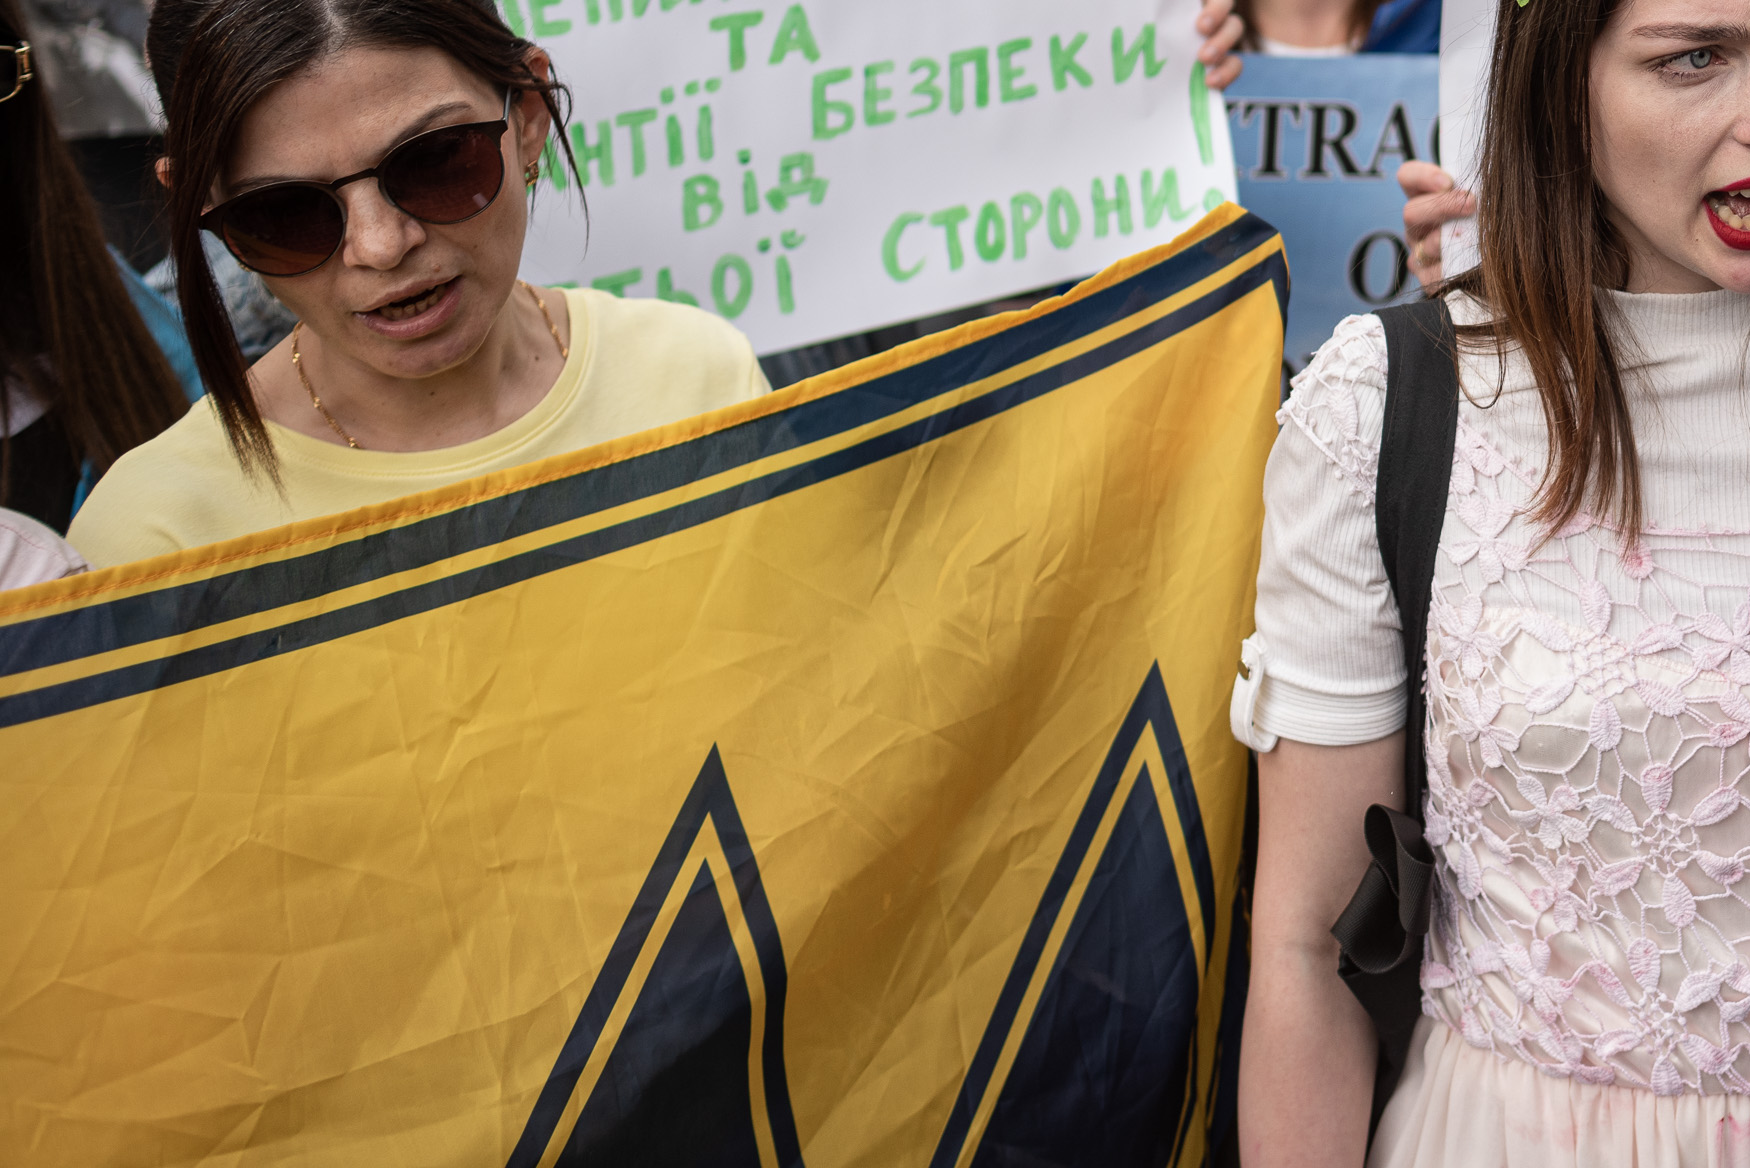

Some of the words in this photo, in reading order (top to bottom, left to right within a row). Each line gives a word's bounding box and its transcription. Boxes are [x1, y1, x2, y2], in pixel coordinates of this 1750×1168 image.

[710, 4, 821, 72] ТА
[810, 22, 1168, 142] БЕЗПЕКИ
[1224, 98, 1440, 182] TRA
